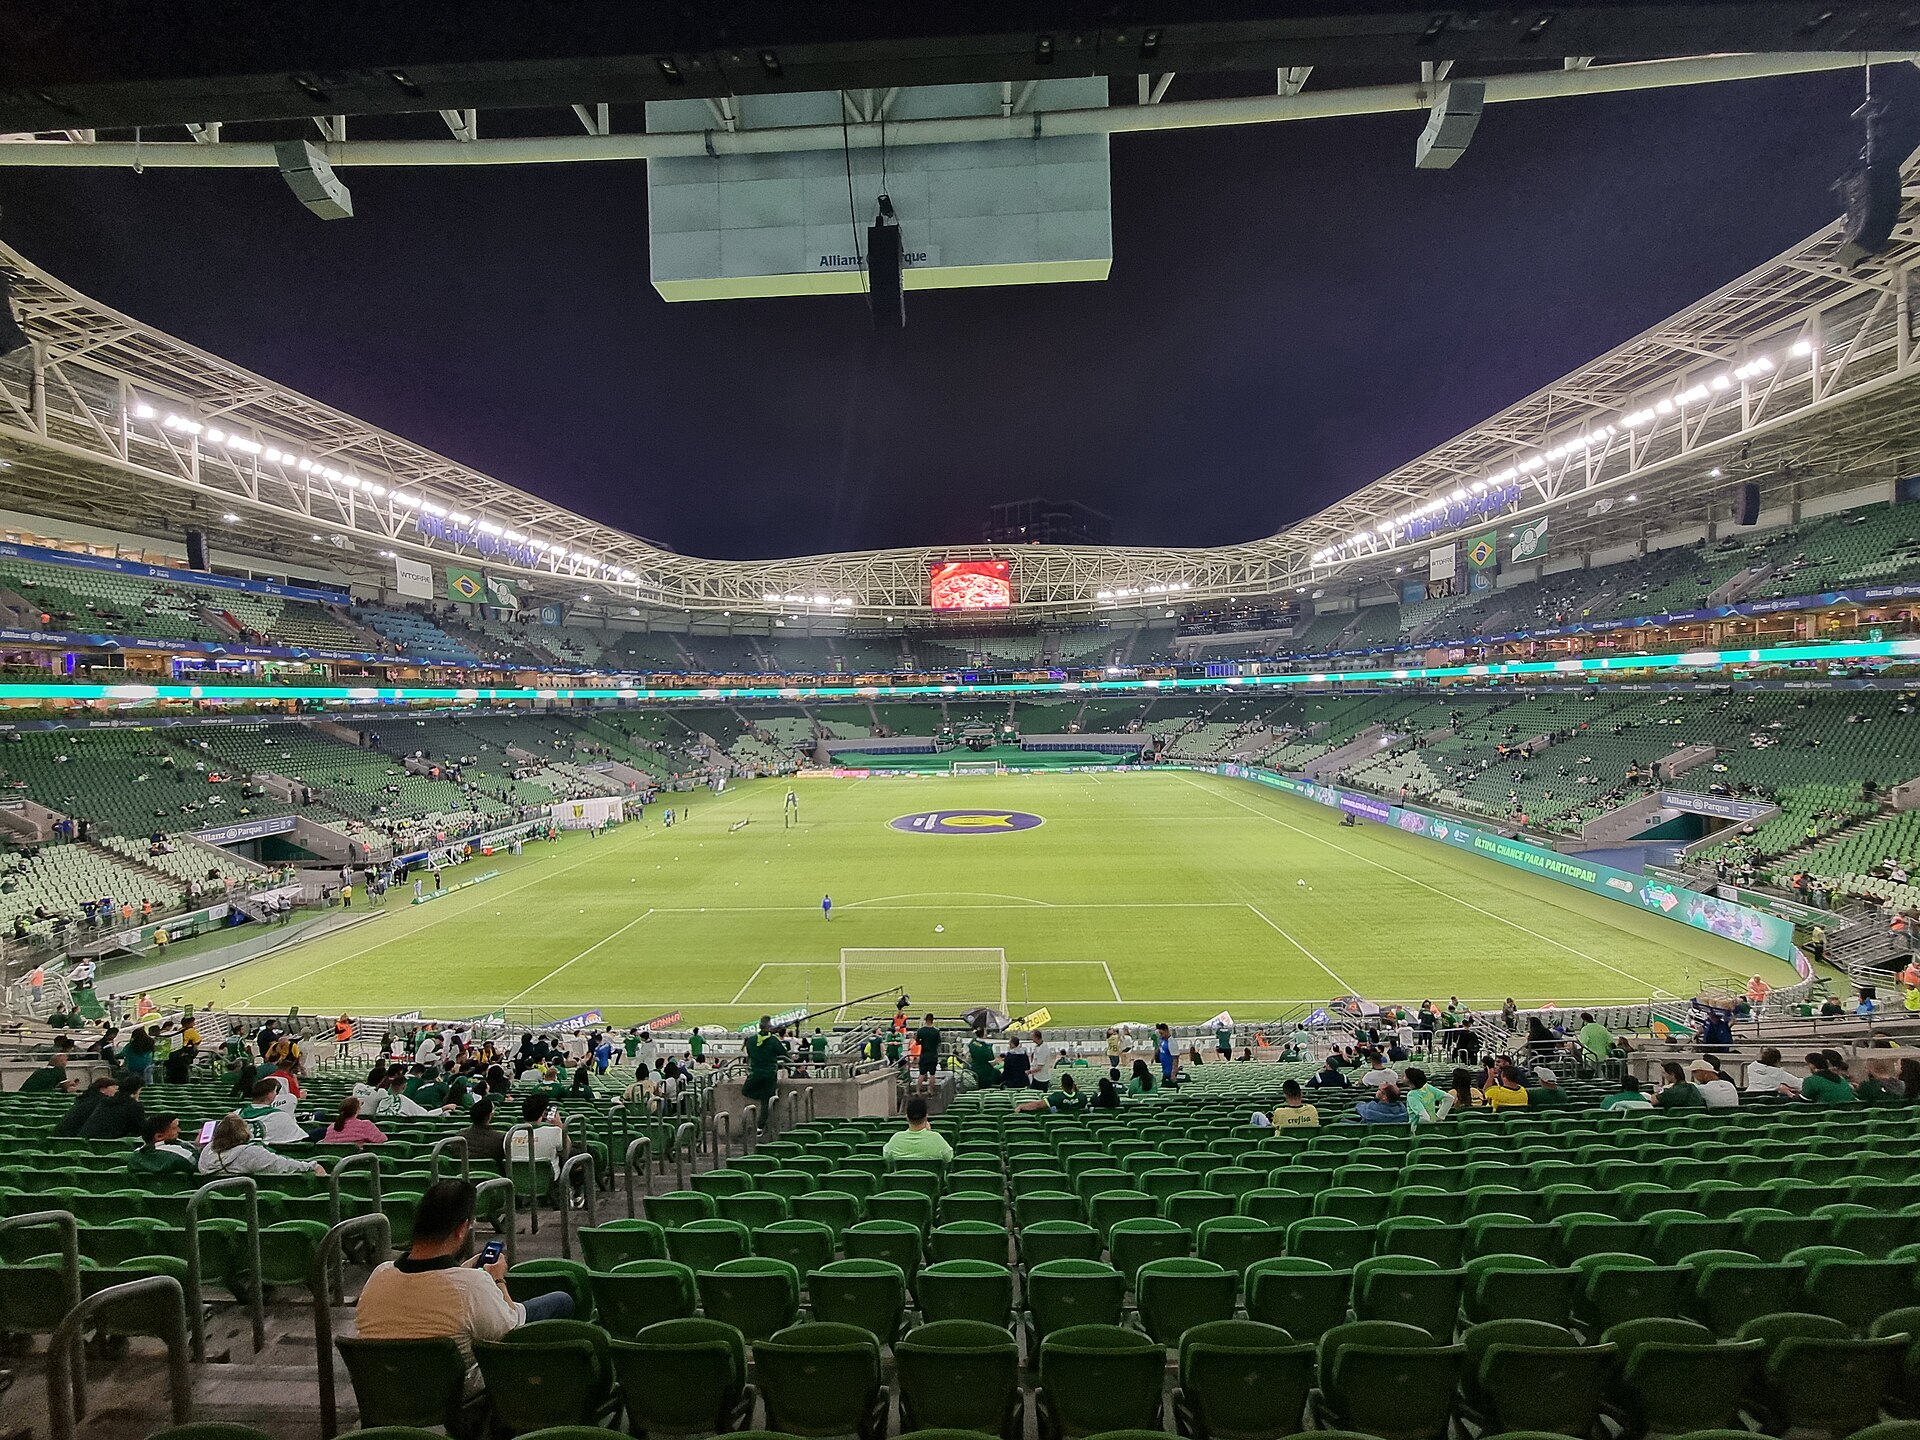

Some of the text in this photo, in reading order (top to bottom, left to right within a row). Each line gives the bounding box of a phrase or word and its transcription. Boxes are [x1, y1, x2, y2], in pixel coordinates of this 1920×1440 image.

[820, 255, 863, 267] Allianz
[1666, 796, 1730, 813] Allianz Parque
[237, 825, 263, 836] Parque
[1474, 836, 1496, 853] ÚLTIMA
[1496, 844, 1524, 861] CHANCE
[1523, 851, 1544, 867] PARA
[1545, 859, 1597, 883] PARTICIPAR!
[650, 1011, 681, 1031] GANHA
[1287, 1115, 1311, 1125] crefisa
